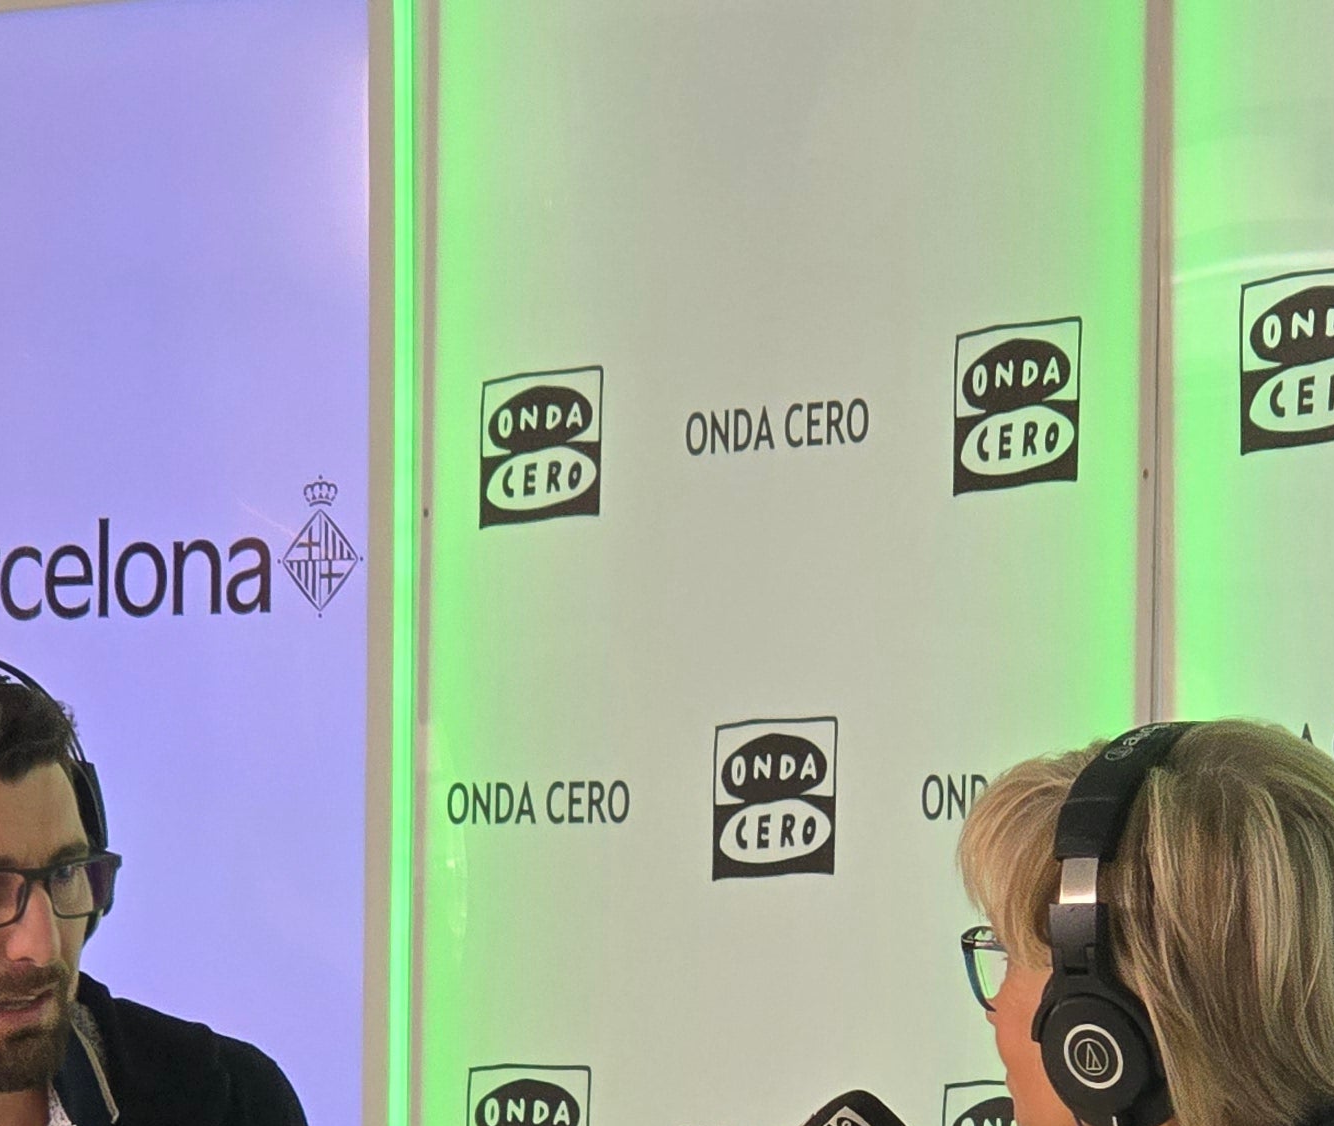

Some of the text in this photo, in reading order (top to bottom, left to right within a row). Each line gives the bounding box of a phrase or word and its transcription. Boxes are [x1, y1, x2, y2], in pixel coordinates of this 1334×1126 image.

[973, 357, 1060, 396] ONDA
[498, 402, 582, 438] ONDA
[686, 398, 868, 456] ONDA CERO
[977, 421, 1059, 462] CERO
[503, 461, 582, 497] CERO
[732, 753, 816, 785] ONDA
[448, 780, 629, 824] ONDA CERO
[736, 814, 816, 849] CERO
[485, 1098, 570, 1126] ONDA
